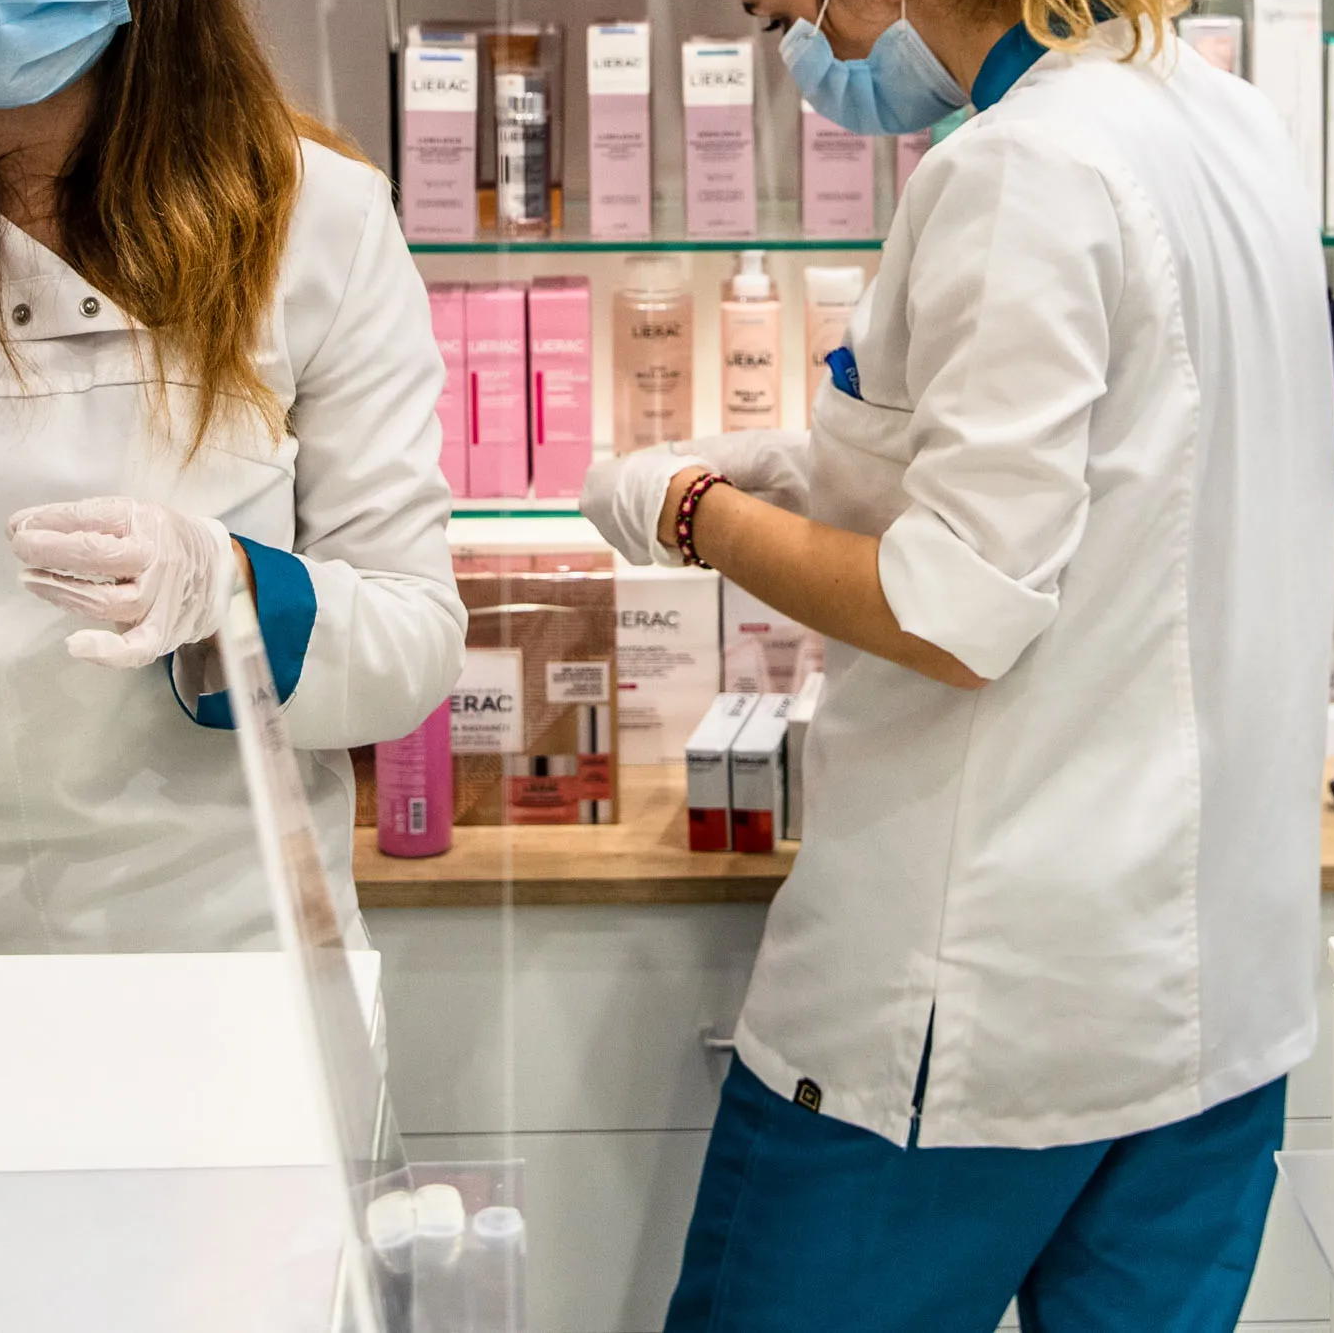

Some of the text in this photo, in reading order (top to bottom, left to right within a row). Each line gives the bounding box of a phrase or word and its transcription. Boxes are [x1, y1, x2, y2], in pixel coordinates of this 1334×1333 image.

[593, 57, 643, 71] LIERAC
[412, 79, 471, 94] LIERAC
[690, 73, 746, 88] LIERAC
[631, 324, 682, 340] LIERAC
[724, 351, 773, 367] LIERAC
[448, 694, 514, 714] ERAC
